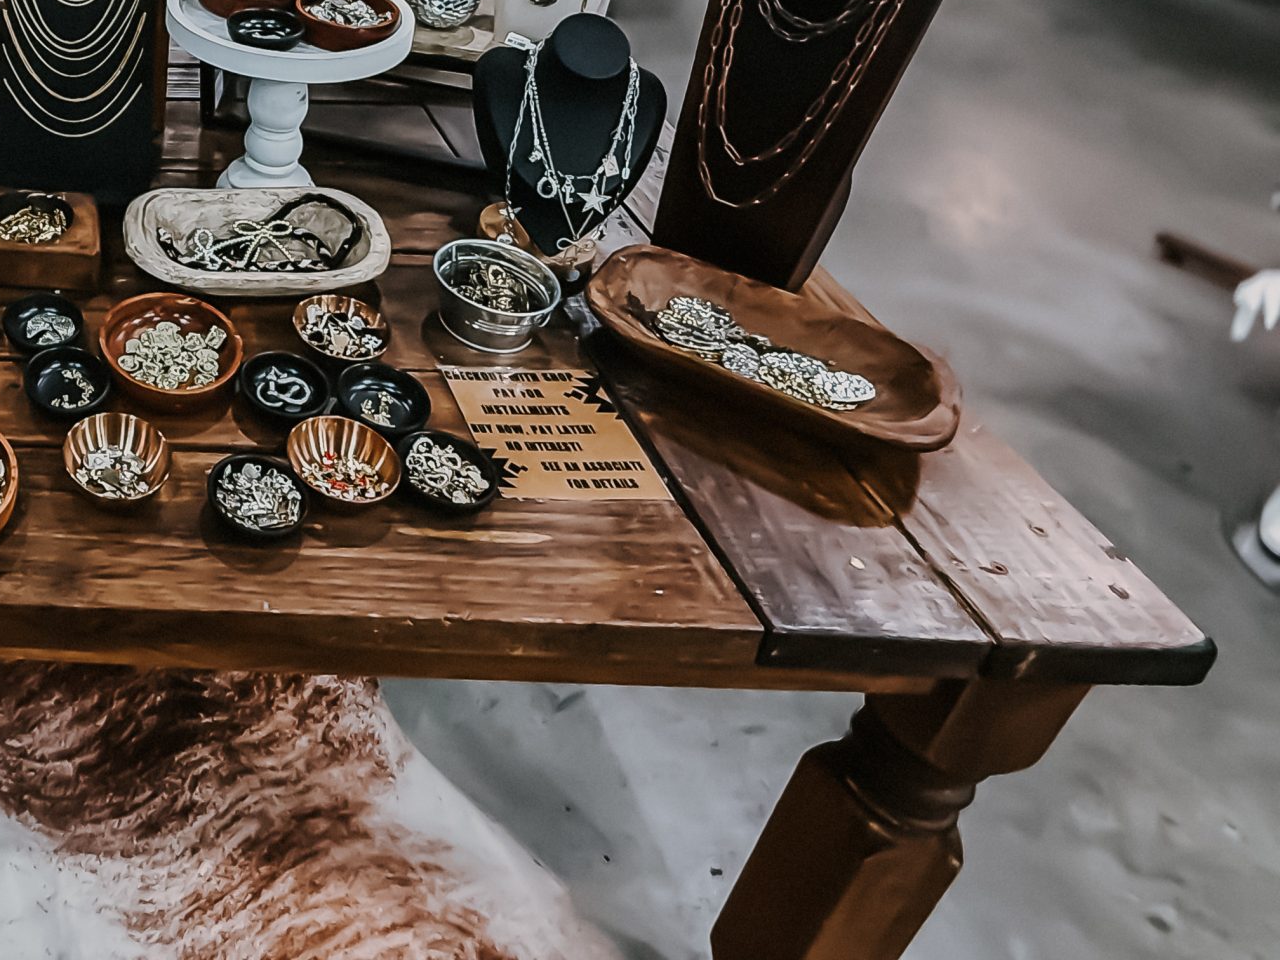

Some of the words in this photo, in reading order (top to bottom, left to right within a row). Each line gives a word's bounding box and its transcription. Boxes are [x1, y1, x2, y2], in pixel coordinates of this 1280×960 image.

[509, 372, 541, 382] WITH
[541, 372, 574, 382] SHOP
[492, 388, 516, 398] PAY
[481, 404, 570, 416] INSTALLMENTS
[470, 423, 492, 434] BUY
[530, 425, 554, 435] PAY
[555, 425, 596, 435] LATER!
[505, 441, 523, 451] NO
[524, 441, 583, 452] INTEREST!
[540, 461, 563, 472] SEE
[563, 461, 581, 472] AN
[582, 461, 646, 472] ASSOCIATE
[566, 478, 590, 489] FOR
[591, 478, 639, 489] DETAILS
